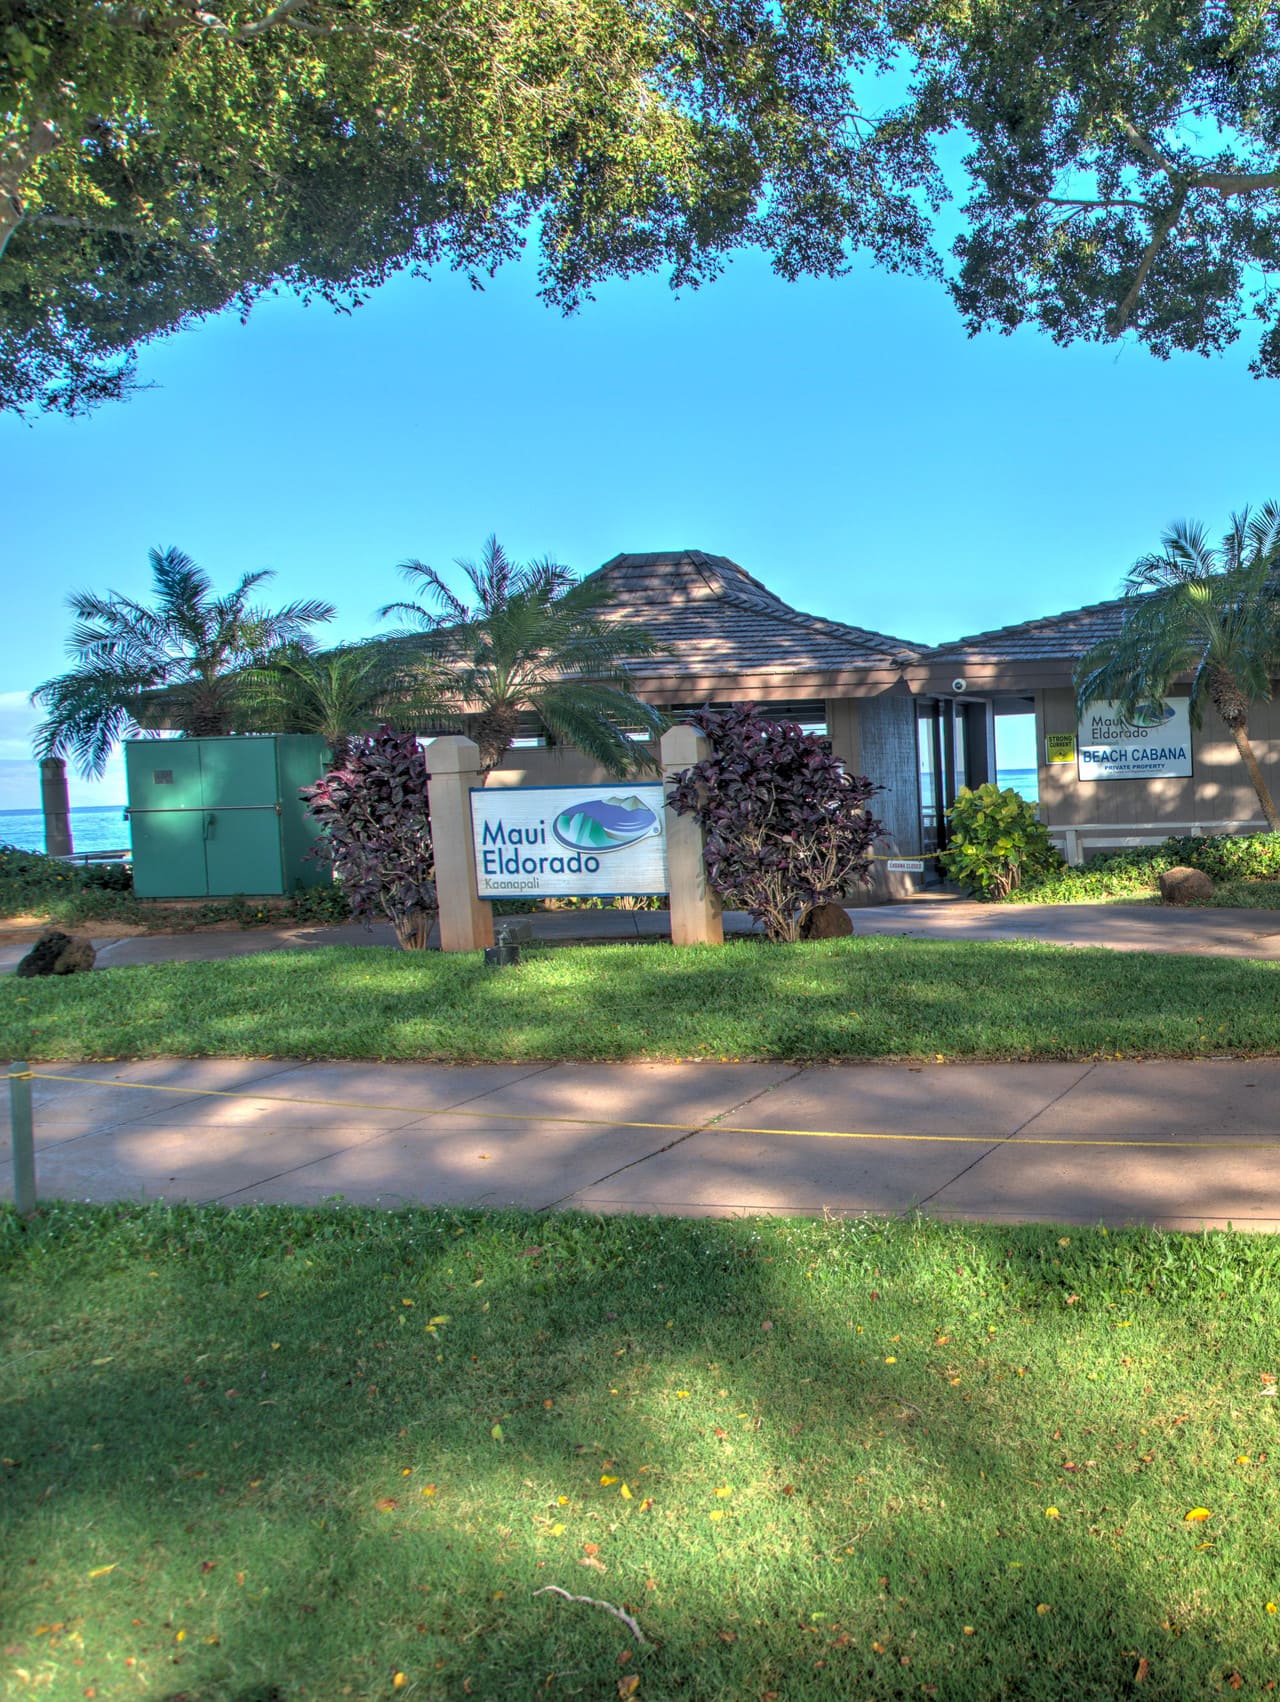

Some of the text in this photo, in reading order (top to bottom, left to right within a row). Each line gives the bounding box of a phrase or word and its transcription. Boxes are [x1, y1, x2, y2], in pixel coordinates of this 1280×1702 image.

[1092, 716, 1123, 726] Mau
[1091, 727, 1148, 739] Eldorado
[1083, 747, 1187, 763] BEACH CABANA
[482, 819, 546, 845] Maui
[482, 847, 600, 874] Eldorado
[484, 877, 540, 892] Kaanapali
